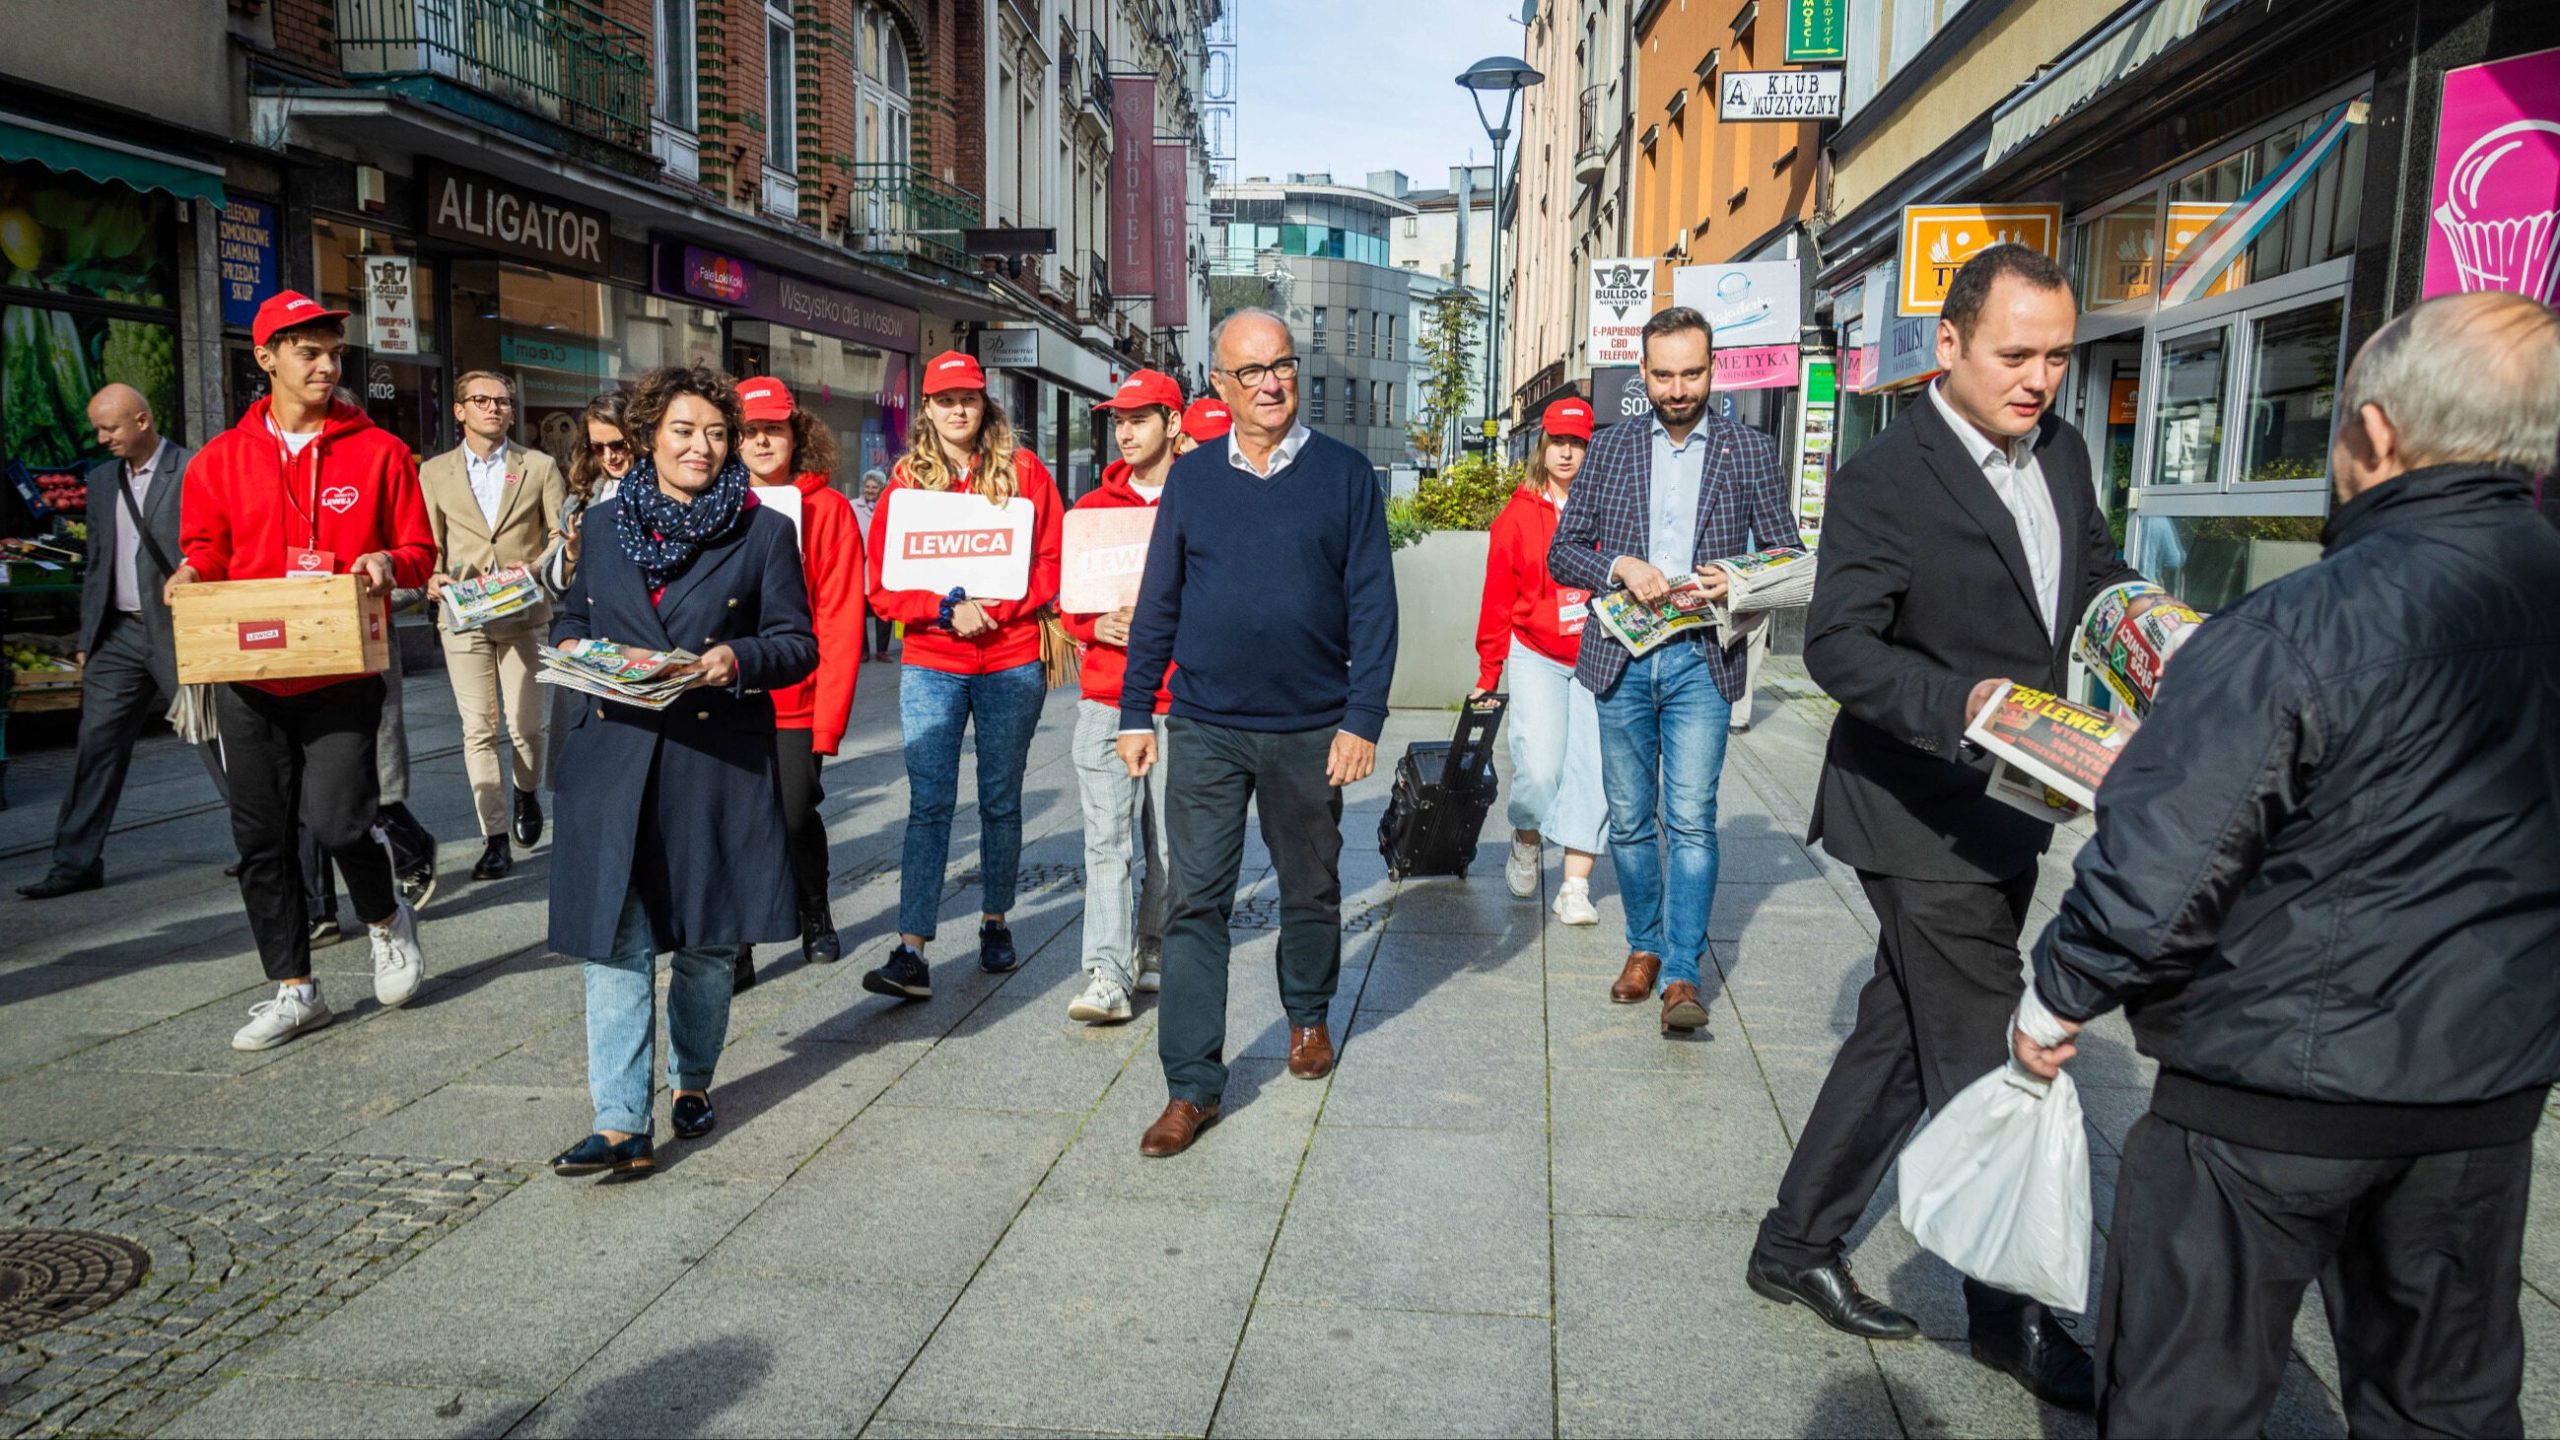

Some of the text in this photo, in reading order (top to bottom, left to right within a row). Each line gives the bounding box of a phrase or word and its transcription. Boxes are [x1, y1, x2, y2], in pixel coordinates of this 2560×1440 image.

[1767, 75, 1820, 95] KLUB
[1752, 95, 1837, 116] MUZYCZNY
[1126, 140, 1139, 266] HOTEL
[437, 178, 601, 263] ALIGATOR
[220, 220, 270, 248] OMÓRKOWE
[221, 240, 261, 264] ZAMIANA
[232, 282, 254, 301] SKUP
[1595, 289, 1647, 300] BULLDOG
[779, 281, 904, 337] Wszystko dla włosów
[929, 329, 934, 346] 5
[1593, 326, 1644, 337] E-PAPIEROS
[1892, 317, 1924, 358] TBILISI
[1611, 338, 1628, 349] CBD
[1599, 350, 1639, 361] TELEFONY
[1716, 352, 1790, 370] METYKA
[909, 532, 1008, 556] LEWICA
[247, 630, 278, 641] LEWICA
[2118, 623, 2150, 668] LEWICY
[2009, 689, 2043, 711] PO
[2040, 701, 2119, 739] LEWEJ
